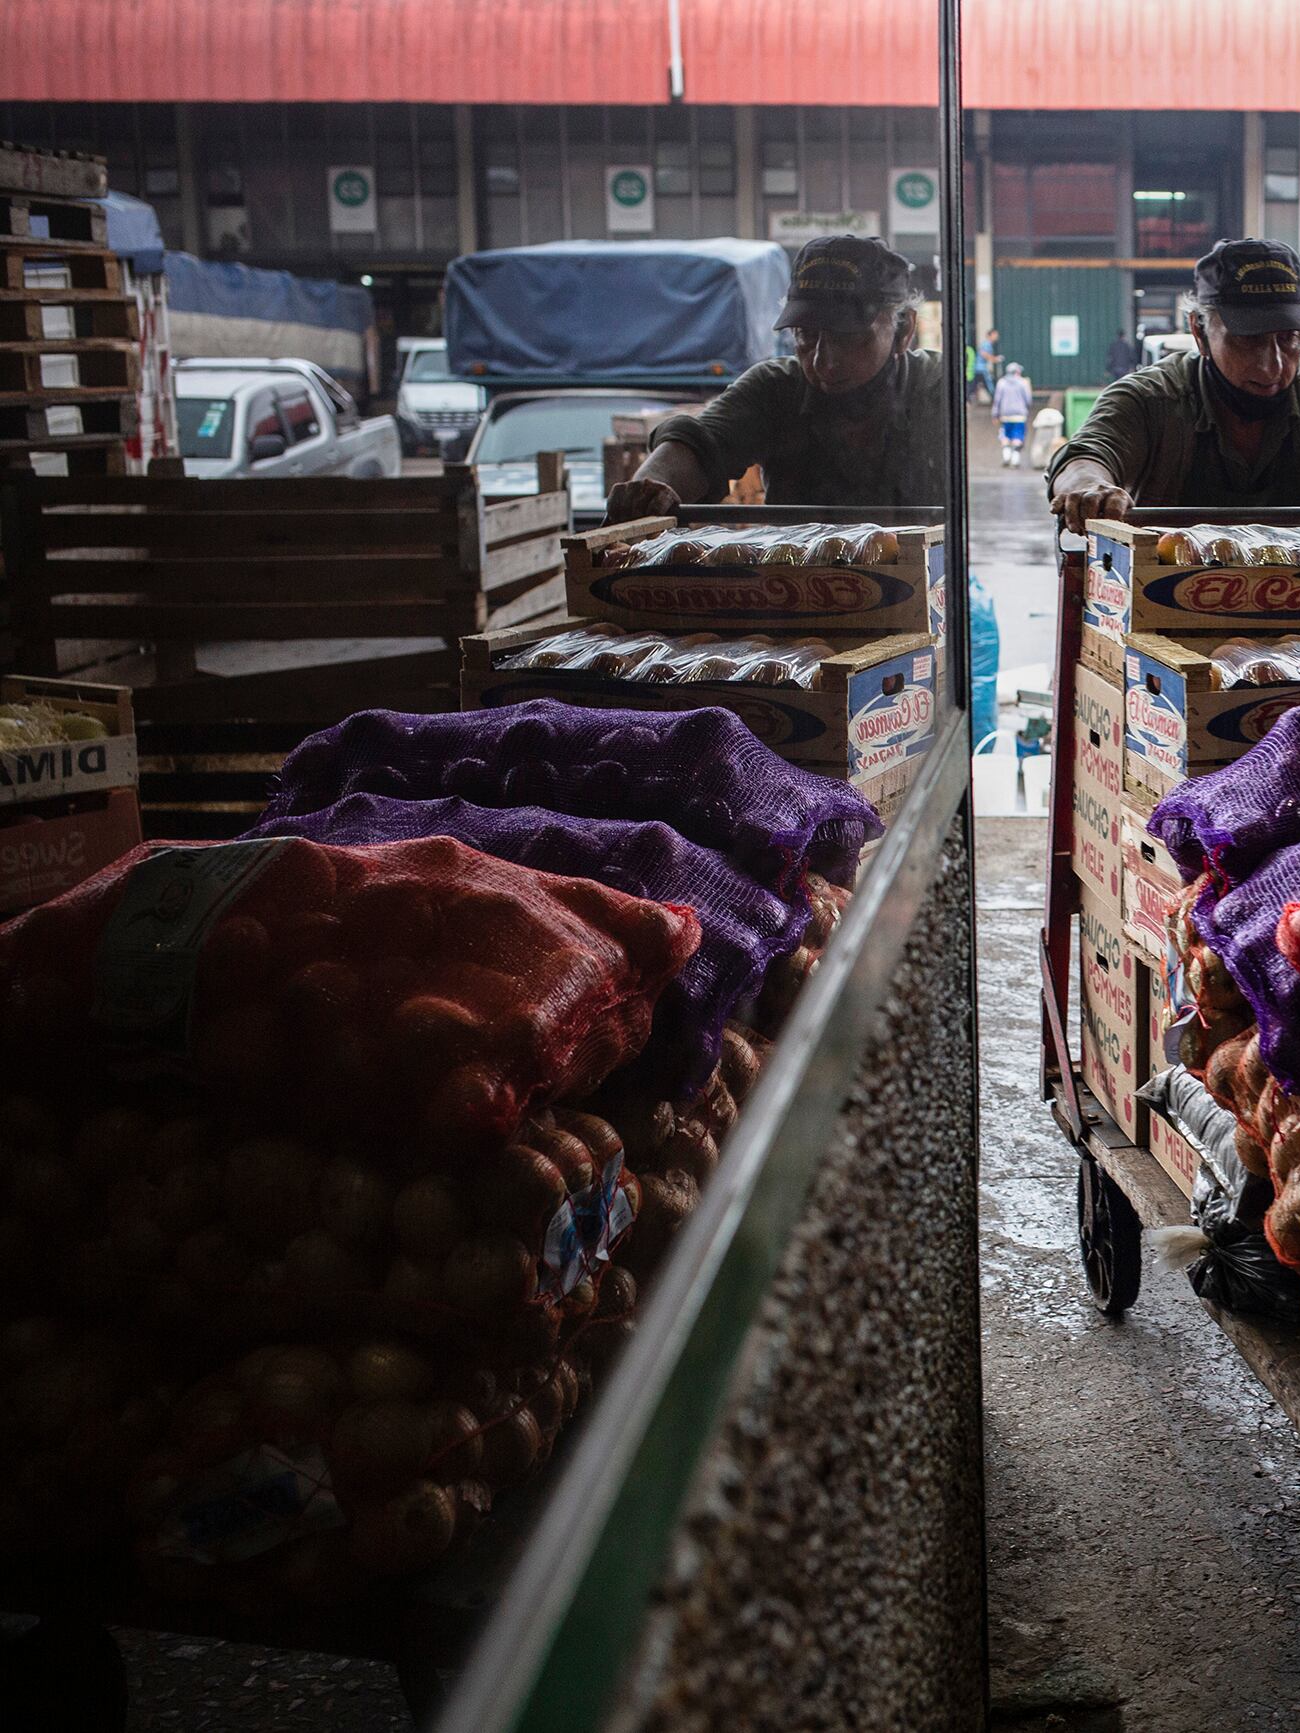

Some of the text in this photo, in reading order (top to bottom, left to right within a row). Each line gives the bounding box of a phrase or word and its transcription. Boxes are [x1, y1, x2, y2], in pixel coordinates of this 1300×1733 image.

[1188, 573, 1244, 612] El
[1142, 695, 1180, 740] Carmen
[1081, 738, 1121, 797] POMMES
[1087, 955, 1131, 1027] POMMES
[1164, 1122, 1194, 1186] MELE
